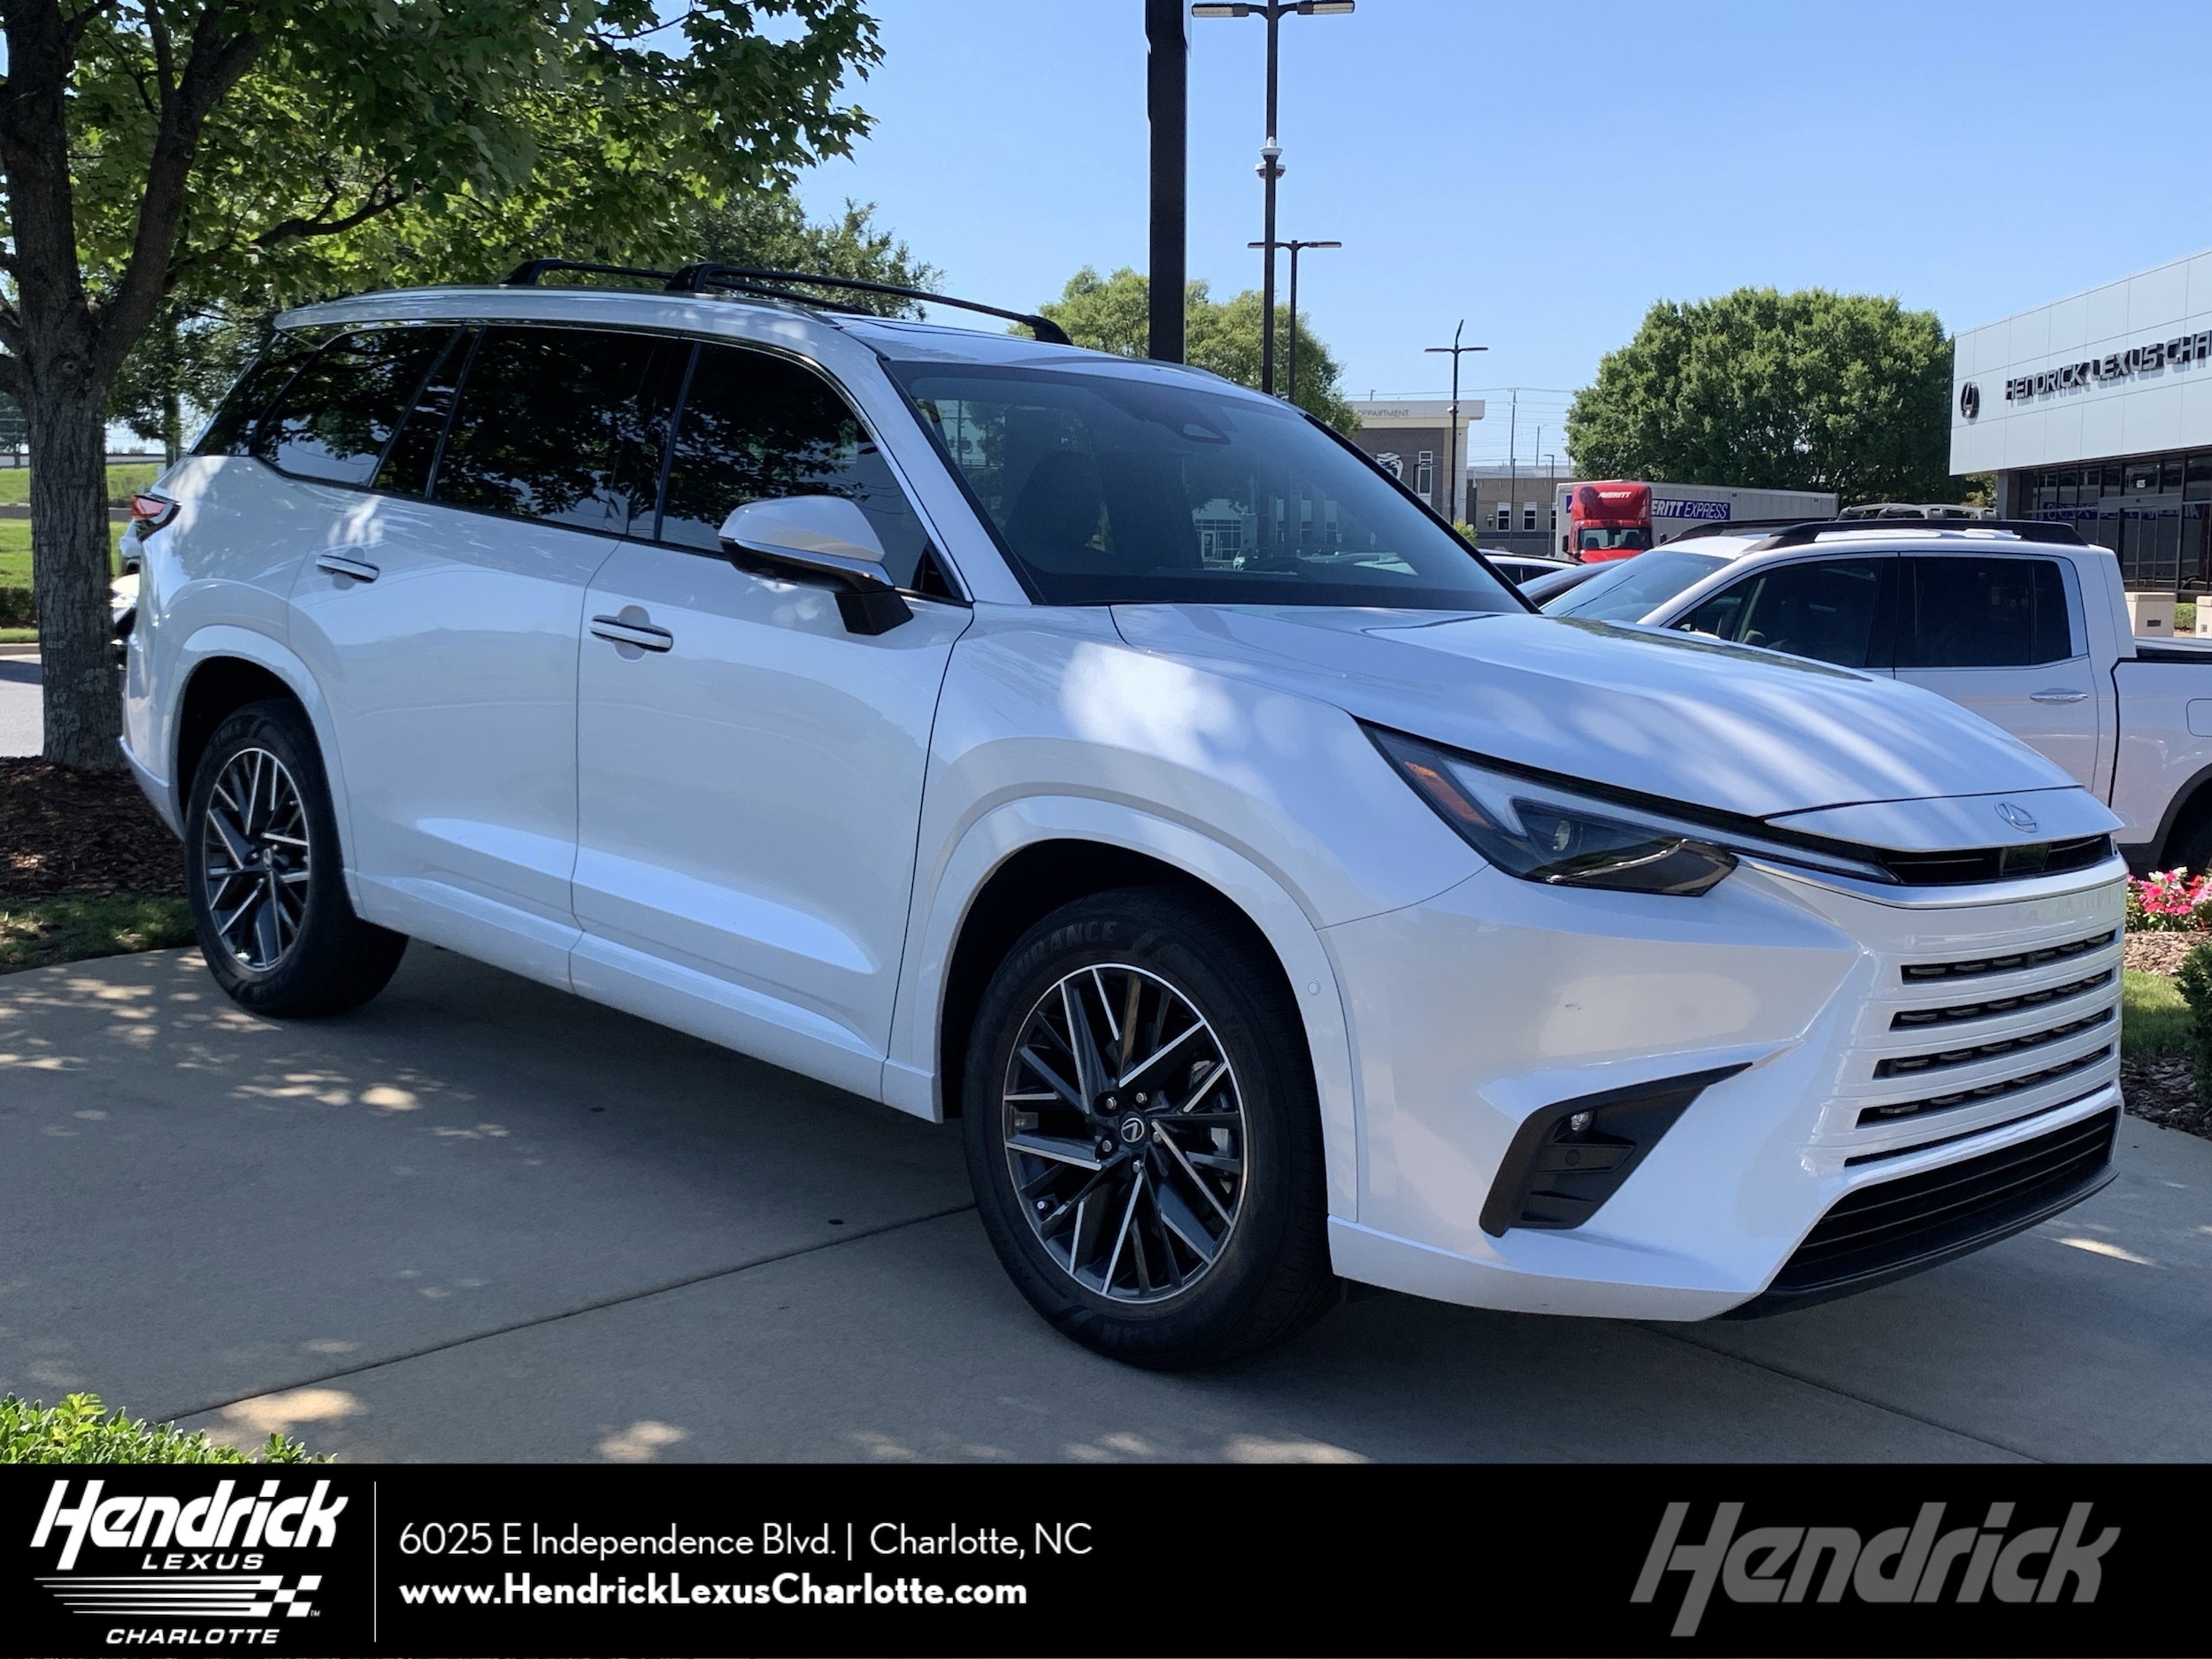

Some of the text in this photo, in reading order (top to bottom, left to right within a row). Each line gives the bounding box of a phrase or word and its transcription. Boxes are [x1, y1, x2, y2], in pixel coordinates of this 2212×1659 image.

[2005, 329, 2212, 401] HENDRICK LEXUS CHA
[1357, 409, 1409, 418] DEPARTMENT
[1651, 500, 1729, 520] ERITT EXPRESS
